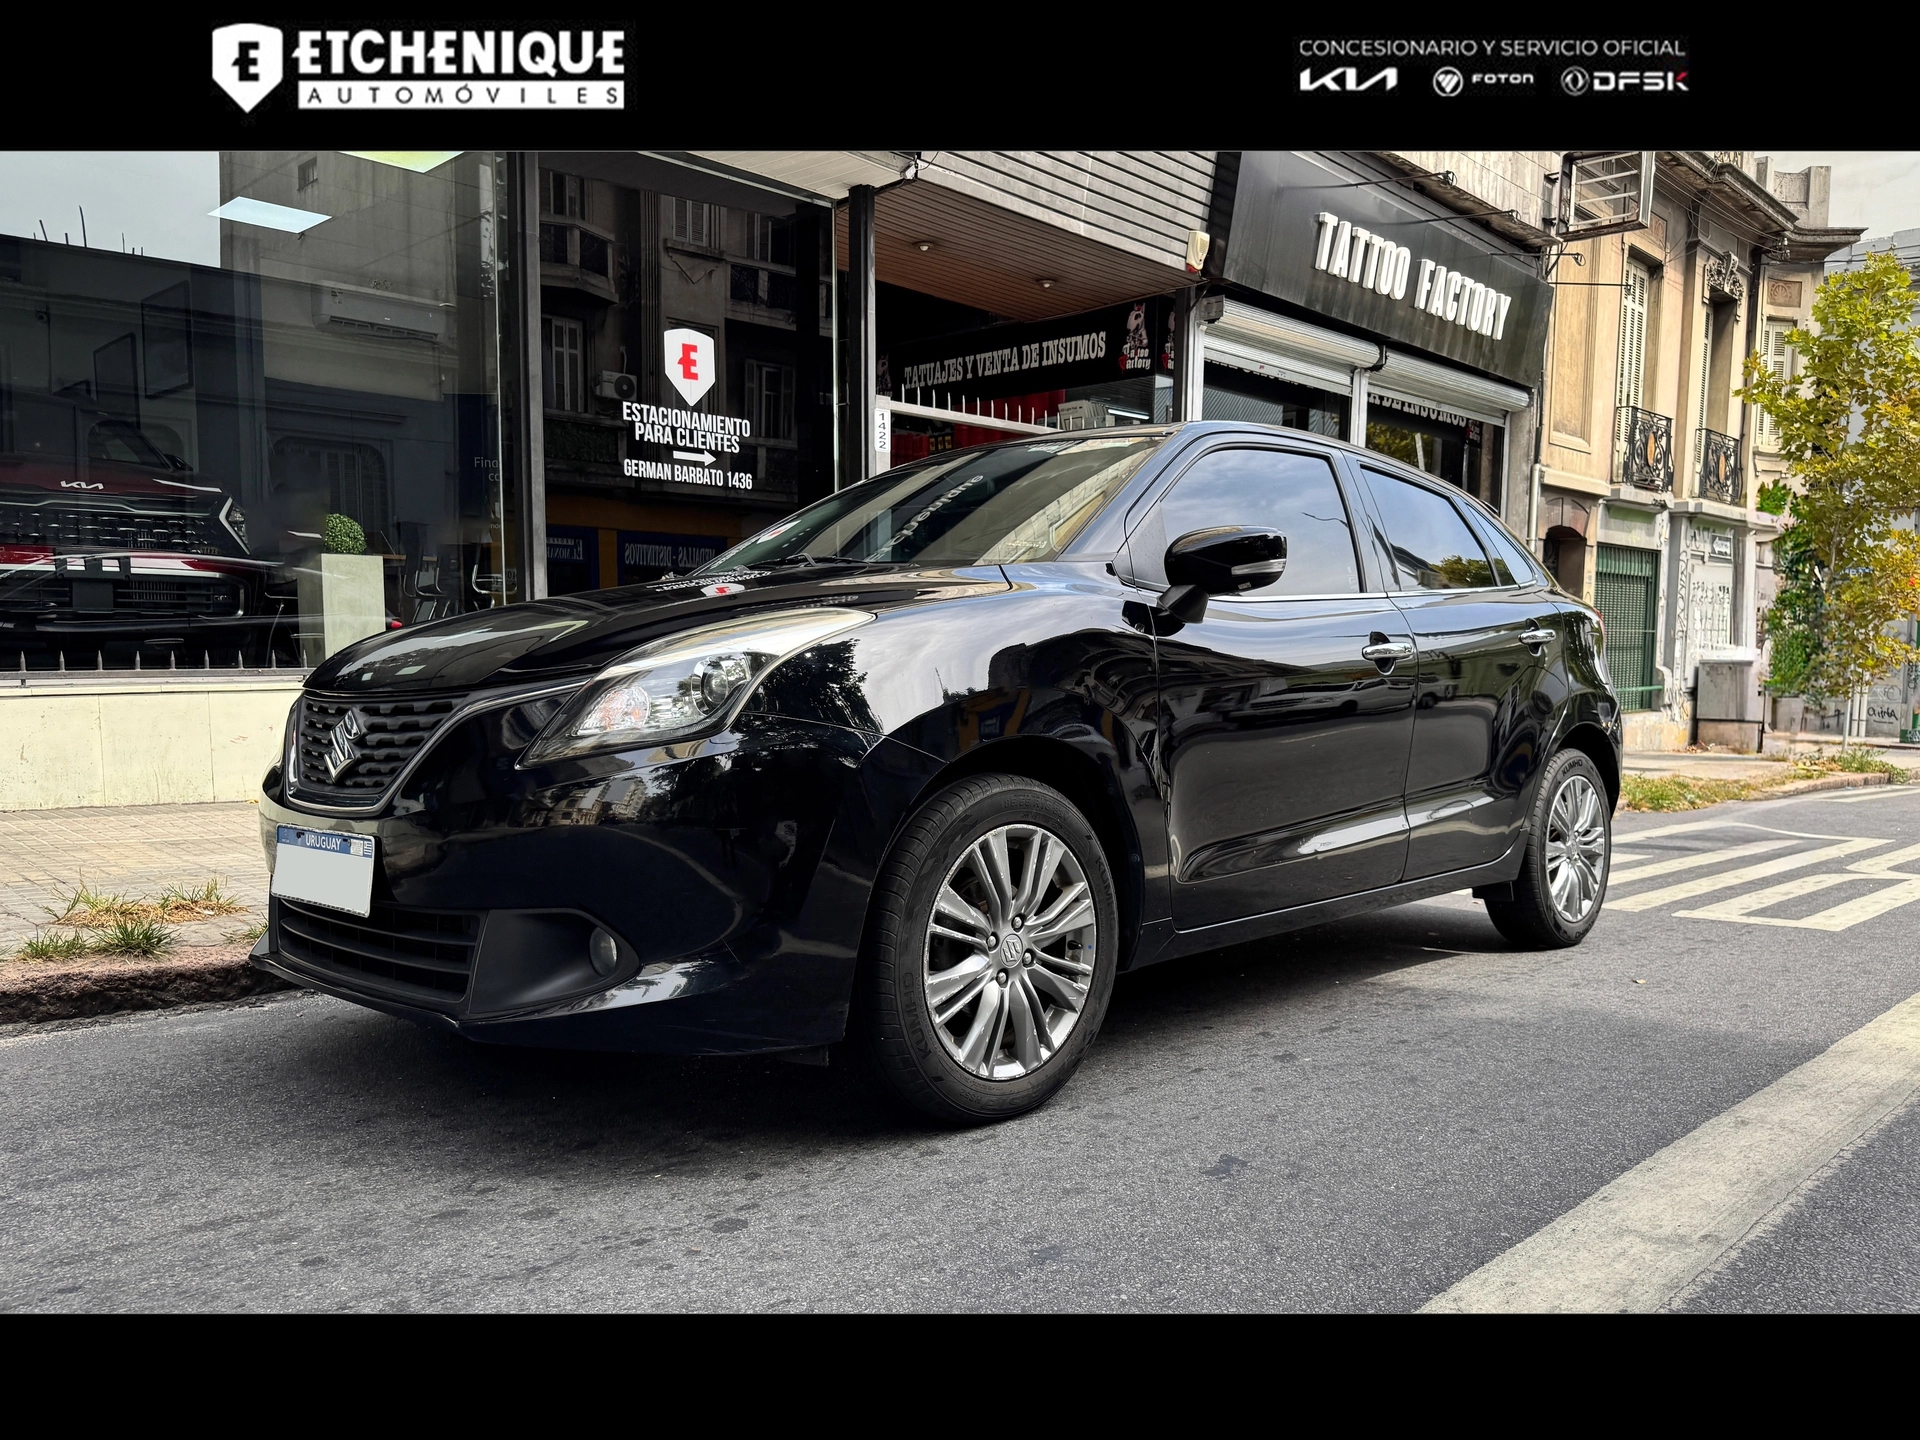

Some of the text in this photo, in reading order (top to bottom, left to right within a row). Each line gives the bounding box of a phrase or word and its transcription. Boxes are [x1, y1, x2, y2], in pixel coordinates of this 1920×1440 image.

[1315, 212, 1512, 340] TATTOO FACTORY
[904, 331, 1107, 390] TATUAJES Y VENTA DE INSUMOS
[622, 401, 751, 437] ESTACIONAMIENTO
[878, 412, 887, 450] 1422
[635, 422, 740, 453] PARA CLIENTES
[623, 459, 753, 489] GERMAN BARBATO 1436
[305, 833, 342, 851] URUGUAY
